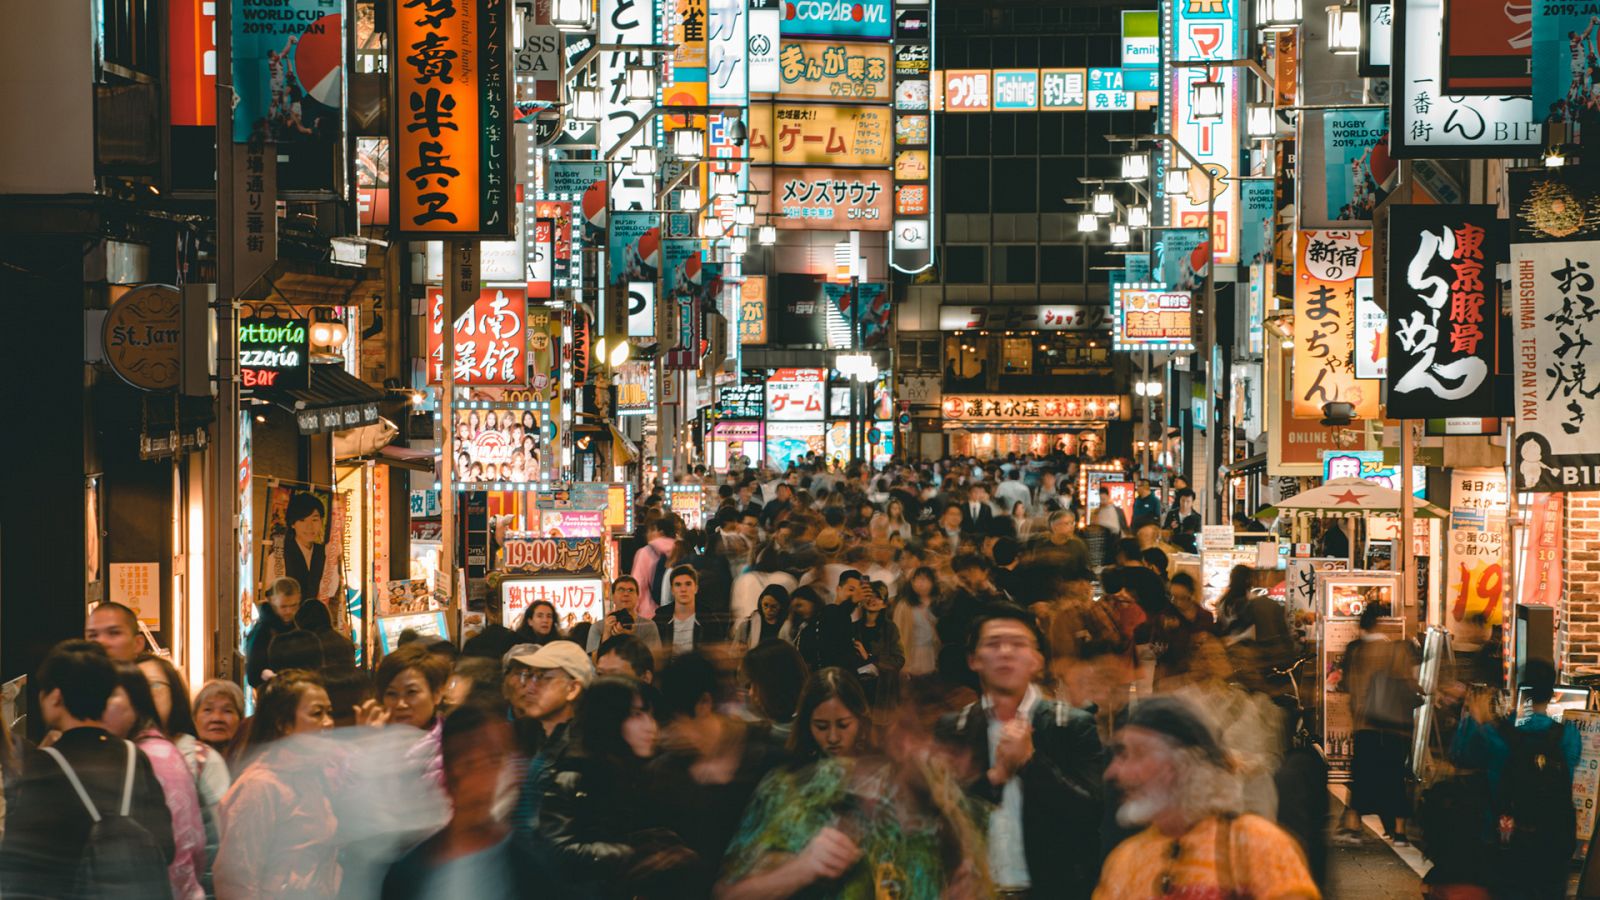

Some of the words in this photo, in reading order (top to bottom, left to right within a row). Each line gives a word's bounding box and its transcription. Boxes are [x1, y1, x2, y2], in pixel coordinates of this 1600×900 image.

[243, 10, 295, 20] WORLD
[296, 10, 326, 20] CUP
[682, 0, 704, 42] 雀
[795, 0, 887, 23] COPABOWL
[1543, 5, 1578, 16] 2019,
[1580, 4, 1600, 15] JA
[243, 24, 278, 35] 2019,
[280, 24, 325, 34] JAPAN
[516, 54, 548, 71] SA
[780, 44, 886, 83] まんが喫茶
[949, 74, 988, 106] つり具
[997, 76, 1034, 106] Fishing
[1044, 73, 1084, 105] 釣具
[1104, 72, 1123, 89] TA
[1096, 93, 1128, 108] 免税
[1410, 78, 1434, 142] 一番街
[779, 124, 847, 155] ゲーム
[1333, 140, 1357, 148] 2019,
[1494, 121, 1537, 142] B1F
[782, 180, 881, 205] メンズサウナ
[1309, 239, 1360, 268] 新宿
[1326, 266, 1342, 279] の
[1449, 223, 1486, 354] 東京豚骨
[1519, 260, 1536, 330] HIROSHIMA
[1128, 328, 1163, 336] PRIVATE
[1304, 284, 1342, 402] まっちゃん
[1544, 258, 1600, 434] お好み焼き
[242, 369, 279, 387] Bar
[772, 393, 821, 412] ゲーム
[1289, 431, 1327, 444] ONLINE
[344, 516, 354, 571] Restaurant
[505, 540, 557, 567] 19:00
[557, 538, 600, 567] オープン
